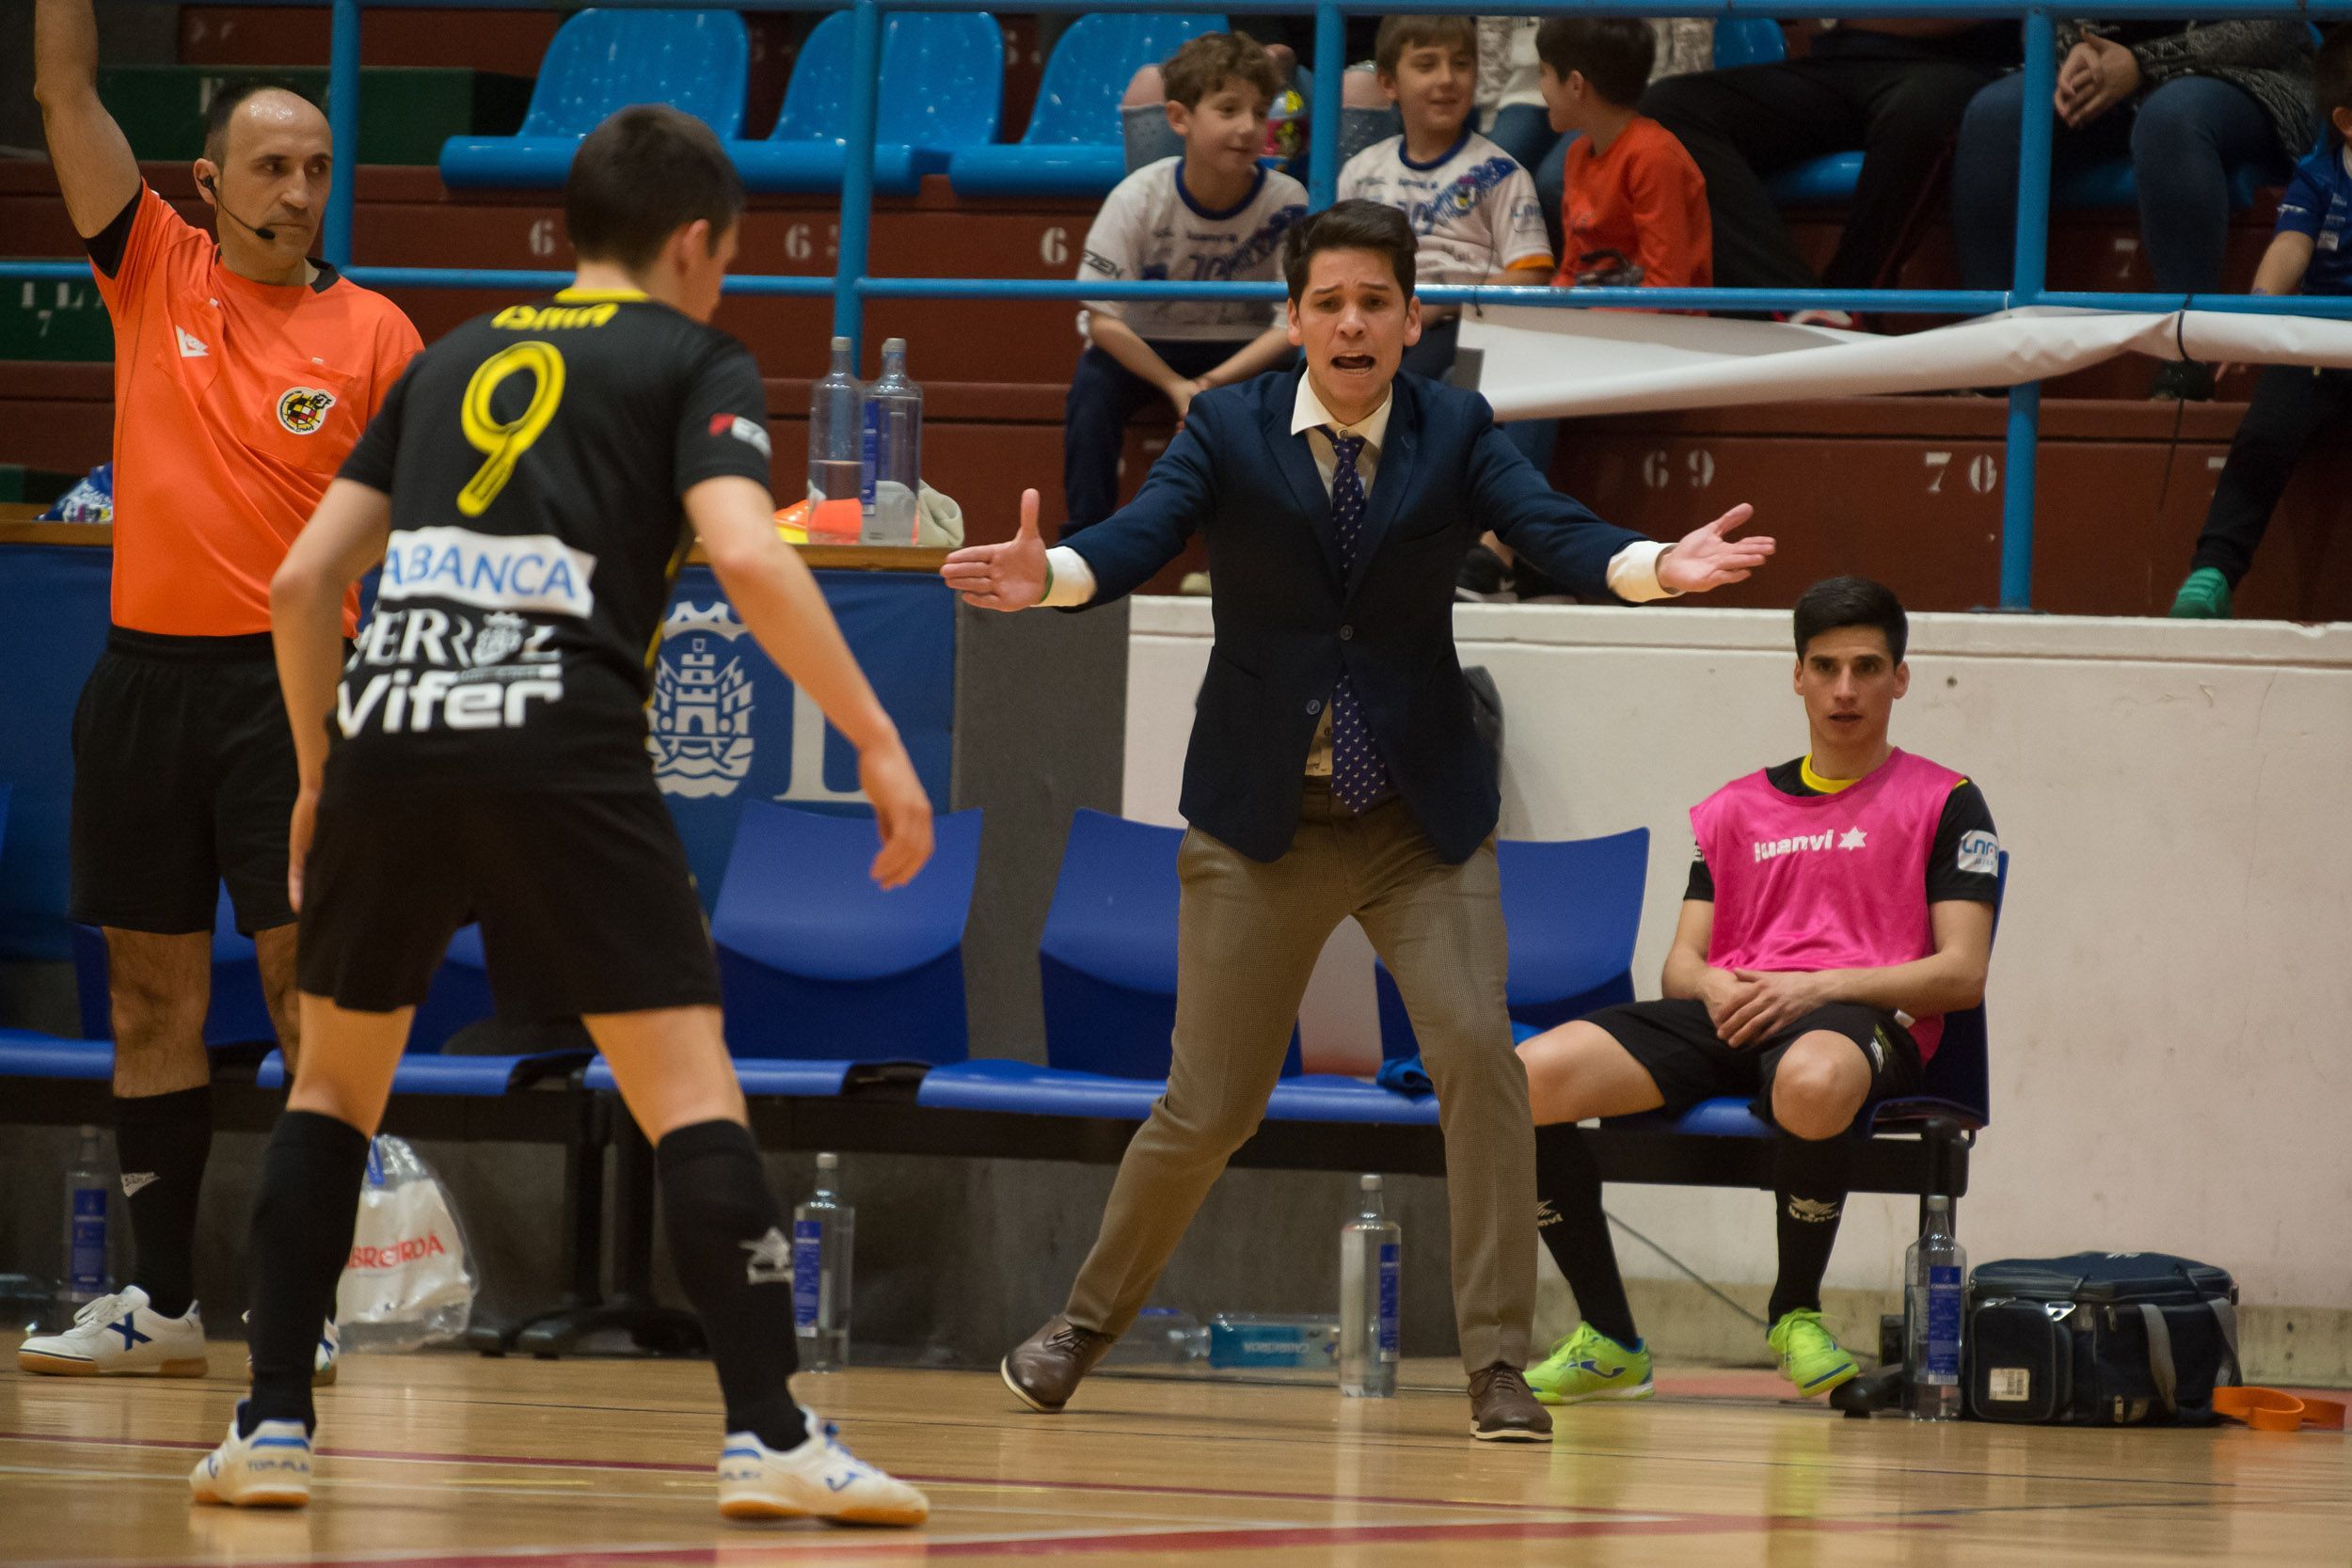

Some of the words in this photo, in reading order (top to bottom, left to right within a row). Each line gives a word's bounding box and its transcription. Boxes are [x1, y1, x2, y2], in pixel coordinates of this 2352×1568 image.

[456, 341, 567, 518] 9
[1924, 451, 1998, 494] 70
[384, 543, 576, 600] ABANCA
[337, 669, 564, 740] Vifer
